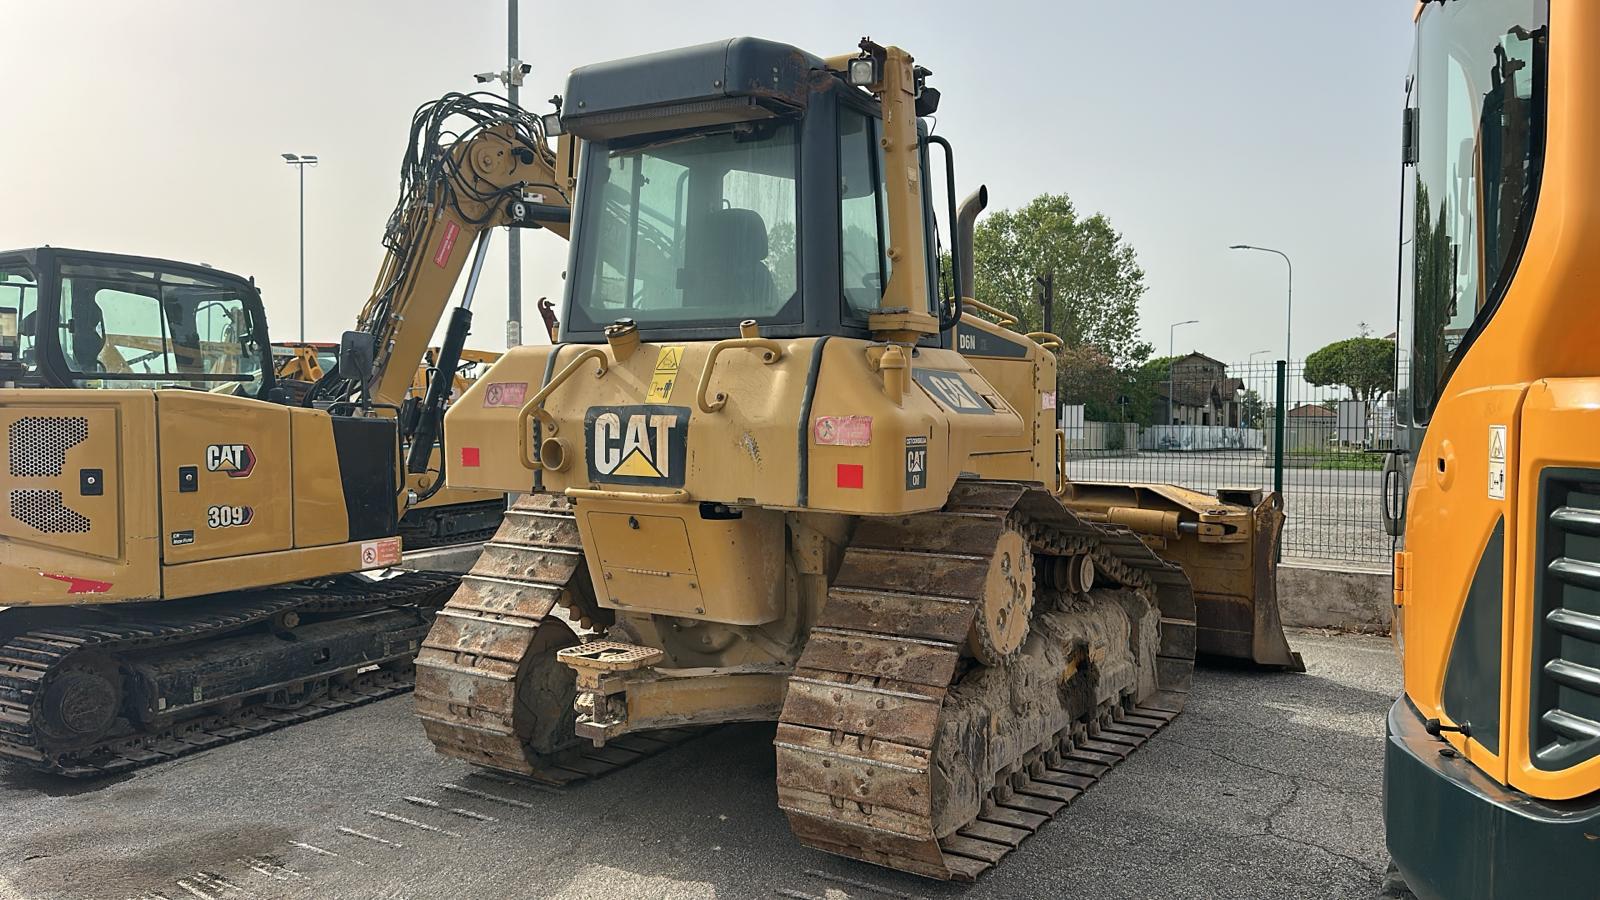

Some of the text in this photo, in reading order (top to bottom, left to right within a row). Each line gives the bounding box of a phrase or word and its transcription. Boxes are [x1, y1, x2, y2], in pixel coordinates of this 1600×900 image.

[960, 334, 976, 350] D6N
[929, 375, 982, 409] CAT
[594, 412, 678, 478] CAT
[207, 445, 244, 471] CAT
[908, 450, 925, 472] CAT
[208, 506, 243, 528] 309
